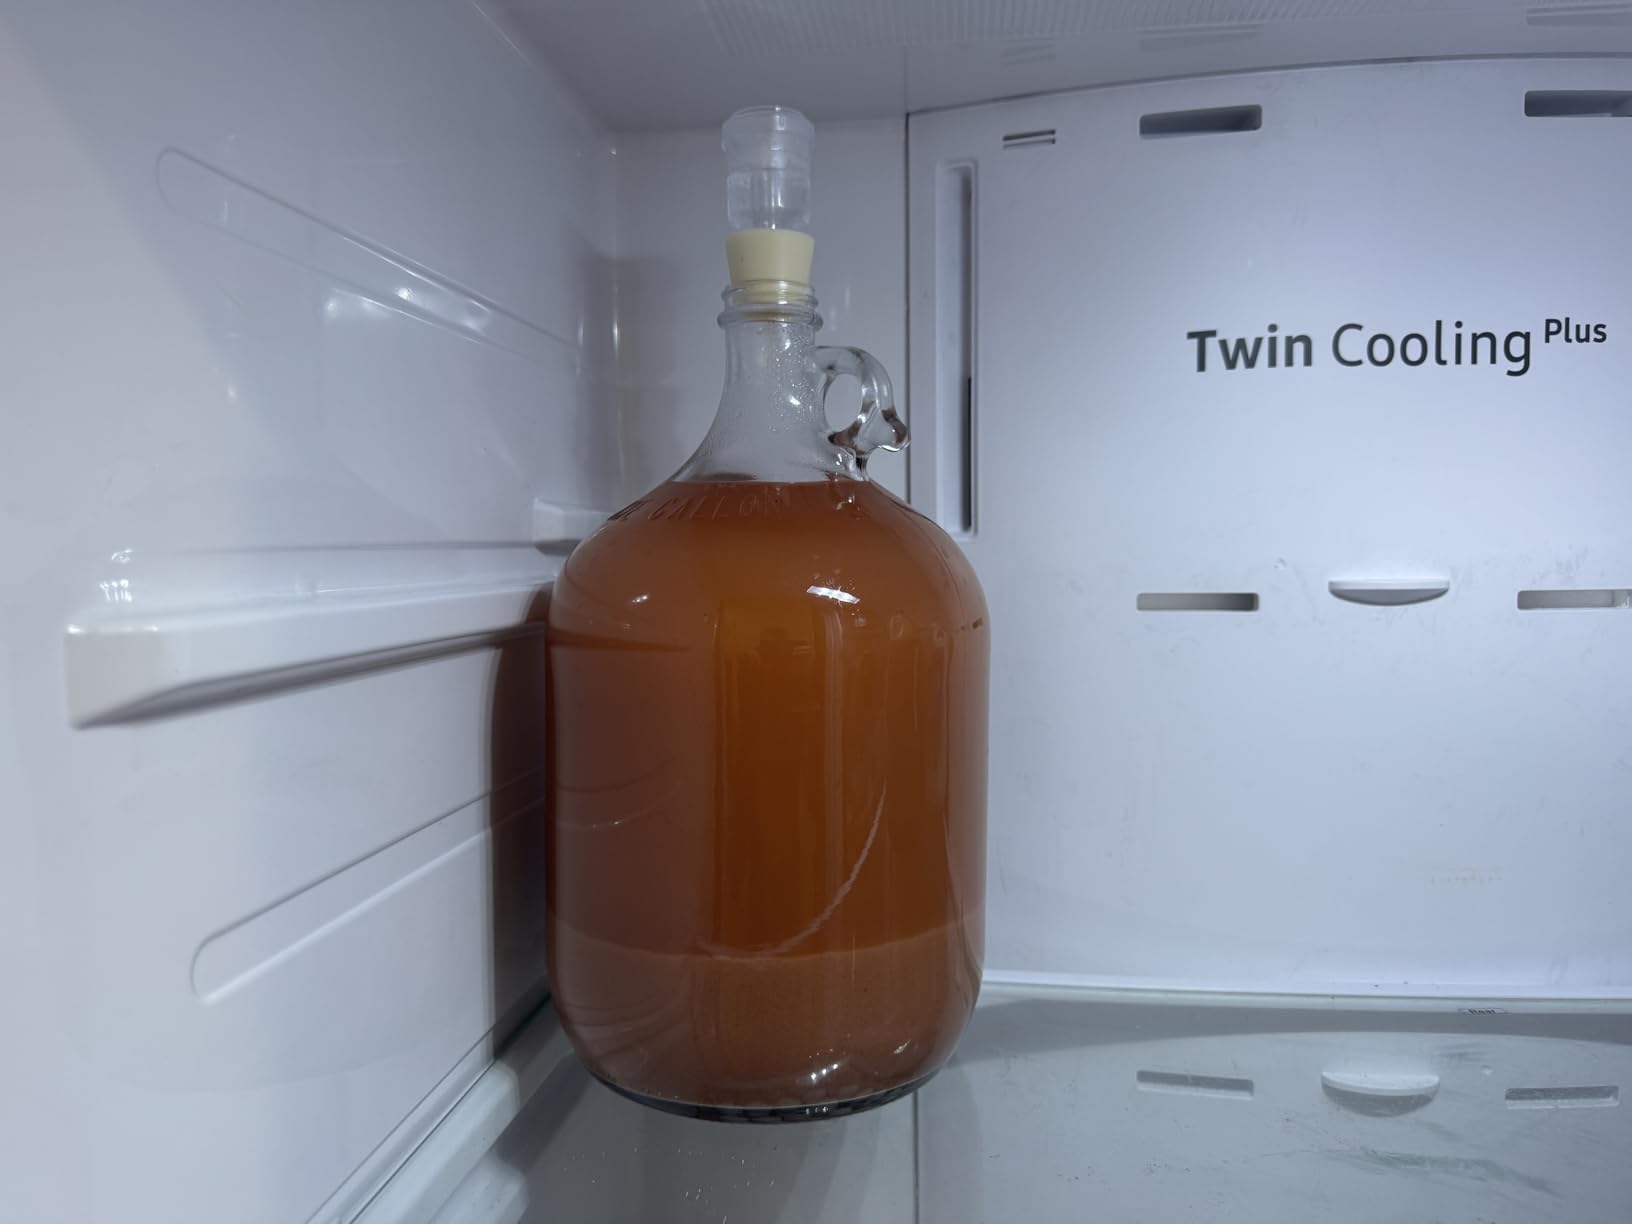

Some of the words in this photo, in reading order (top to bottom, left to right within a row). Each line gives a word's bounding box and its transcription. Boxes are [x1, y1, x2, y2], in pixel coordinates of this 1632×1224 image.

[1186, 323, 1313, 373] Twin
[1332, 319, 1531, 377] Cooling
[1544, 316, 1607, 344] Plus
